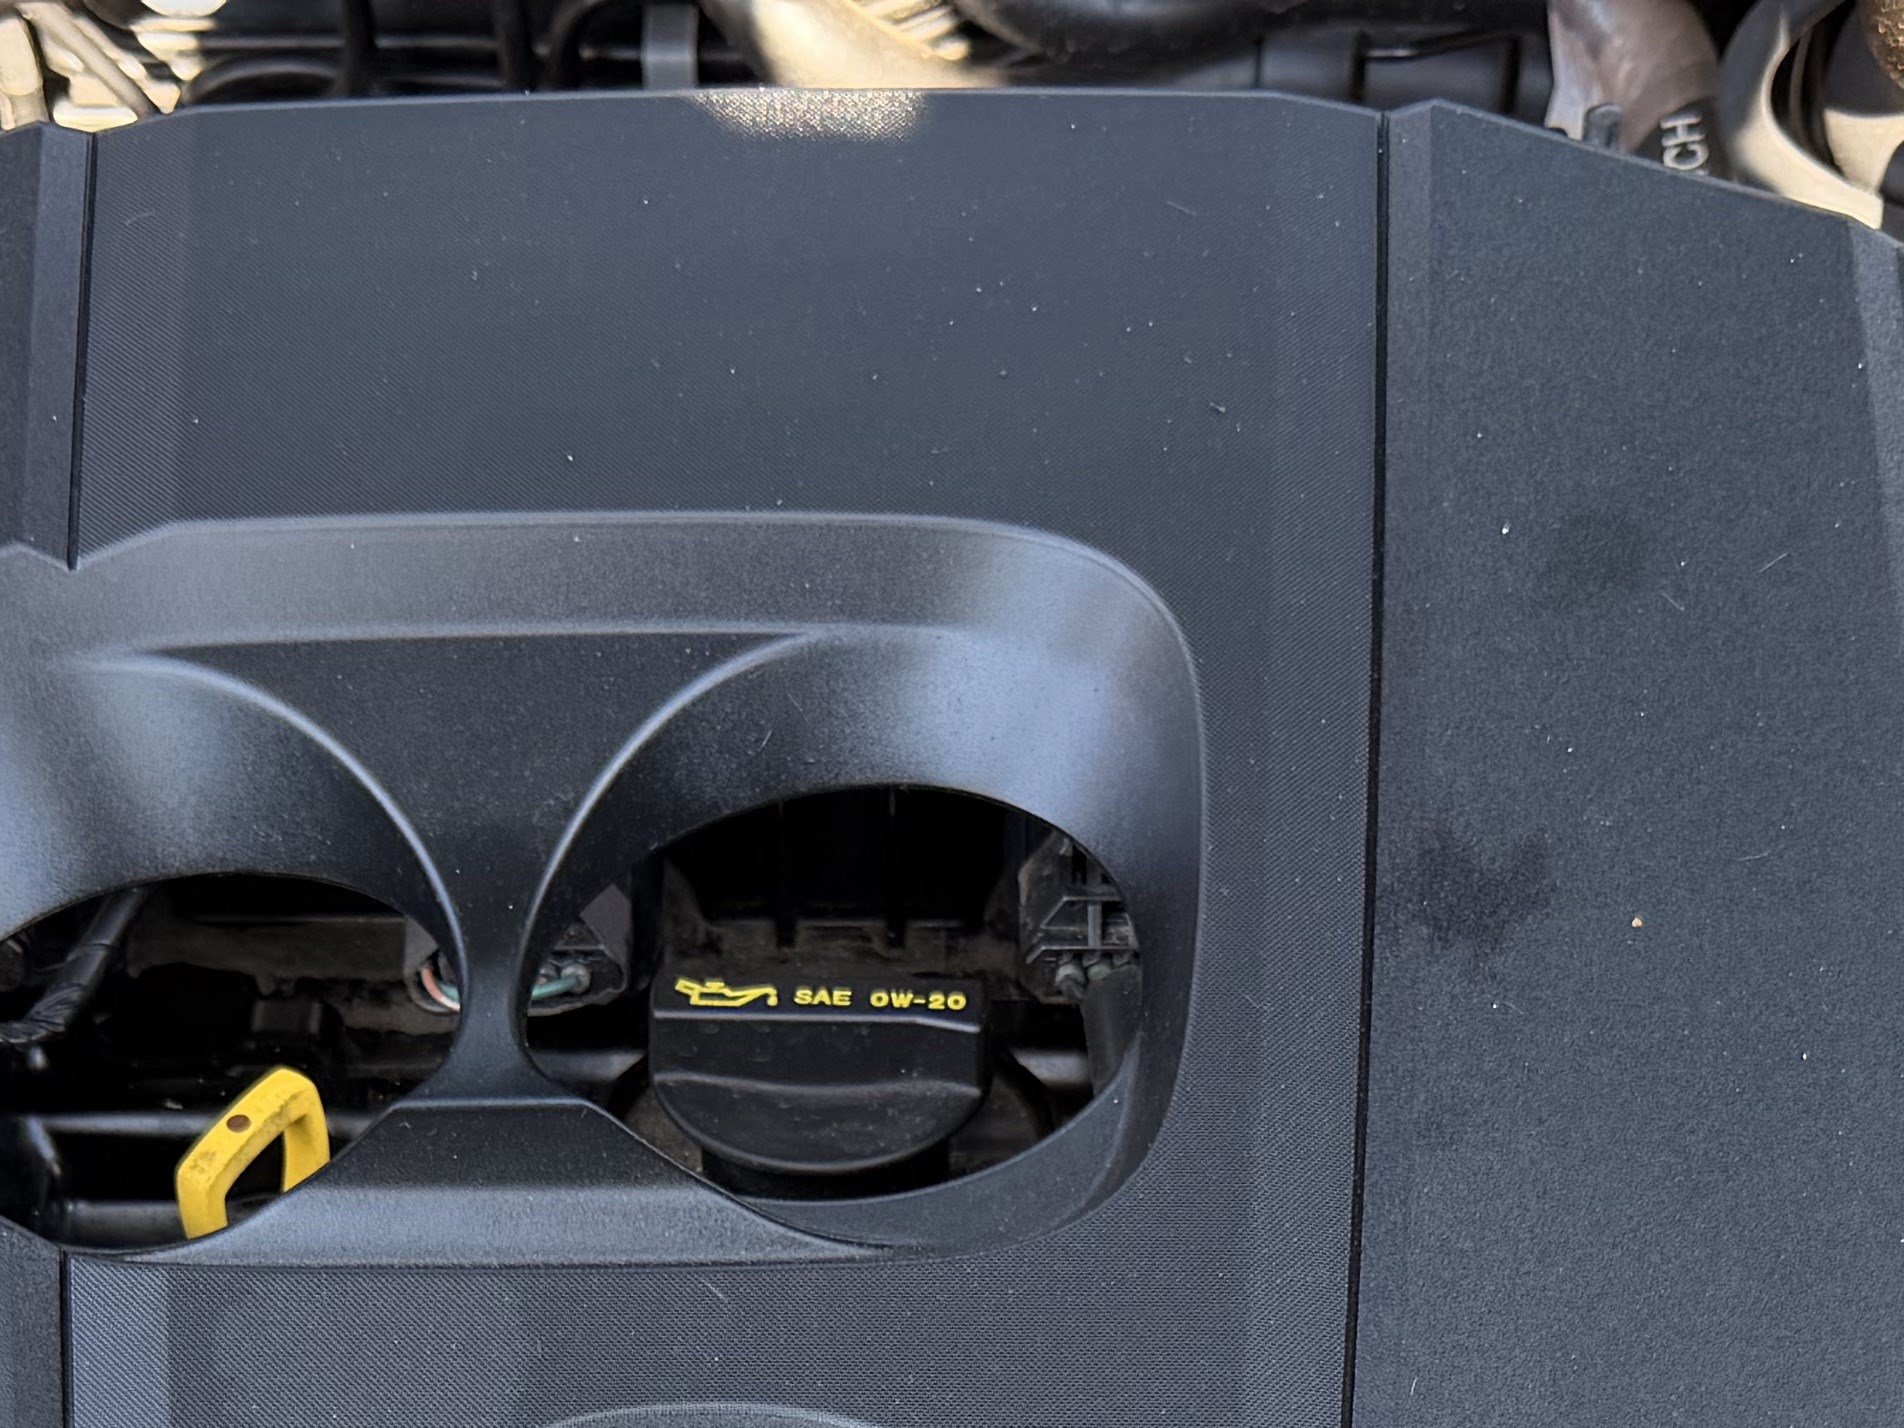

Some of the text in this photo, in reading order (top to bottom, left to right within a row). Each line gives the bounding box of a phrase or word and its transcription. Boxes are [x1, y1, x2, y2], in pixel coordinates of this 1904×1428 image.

[1661, 115, 1709, 175] CH
[793, 986, 968, 1012] SAE 0W-20
